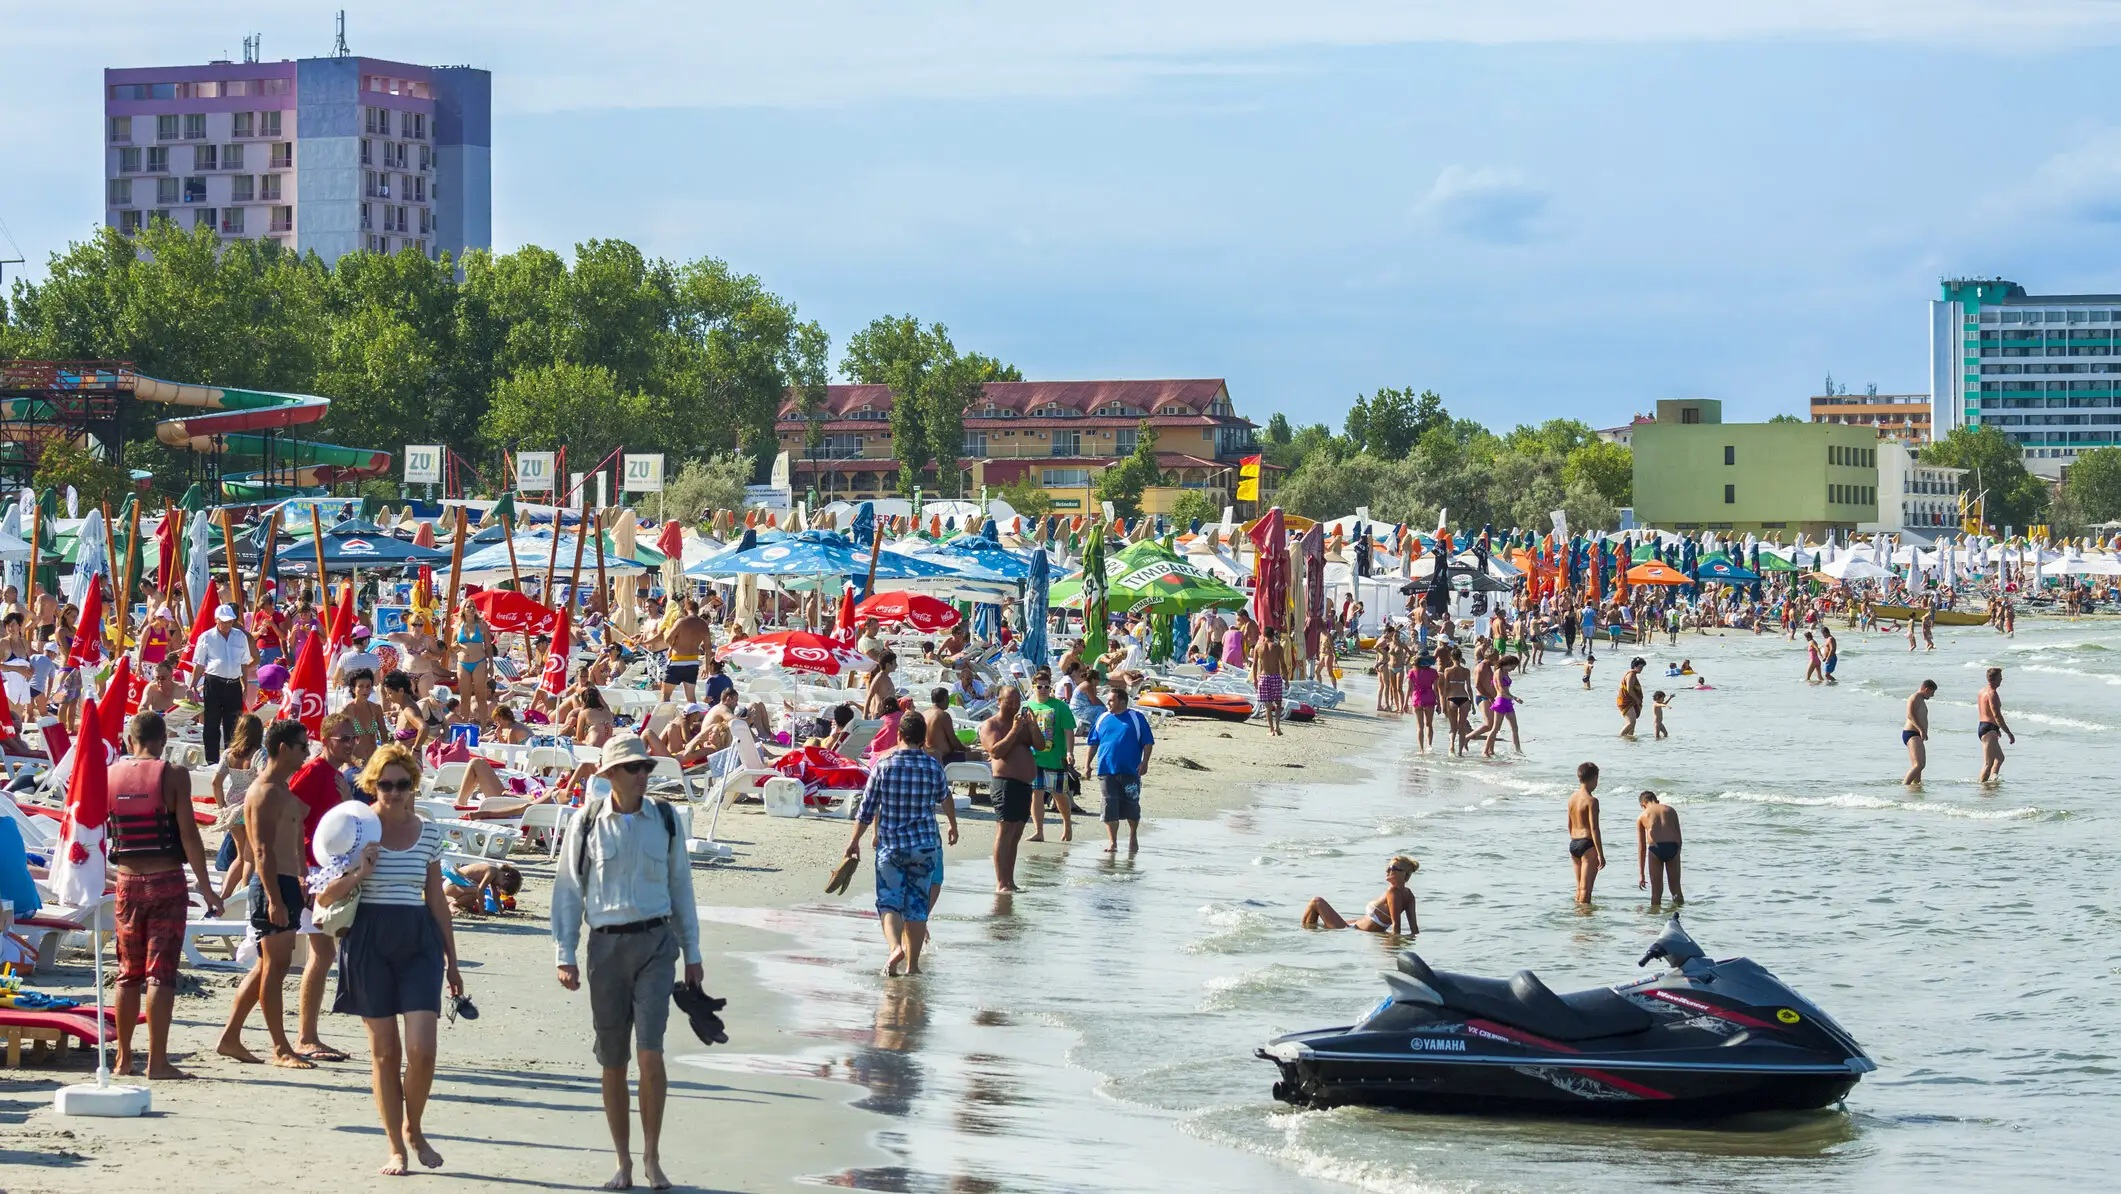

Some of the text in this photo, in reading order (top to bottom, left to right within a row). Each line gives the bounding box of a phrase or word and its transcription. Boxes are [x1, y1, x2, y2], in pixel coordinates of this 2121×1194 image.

[409, 452, 432, 470] ZU
[521, 459, 543, 477] ZU
[628, 460, 650, 478] ZU
[1124, 563, 1204, 586] TYMBARK
[1131, 596, 1163, 613] TYMBARK
[1656, 990, 1710, 1011] WaveRunner
[1468, 1025, 1478, 1035] VX
[1424, 1038, 1466, 1052] YAMAHA
